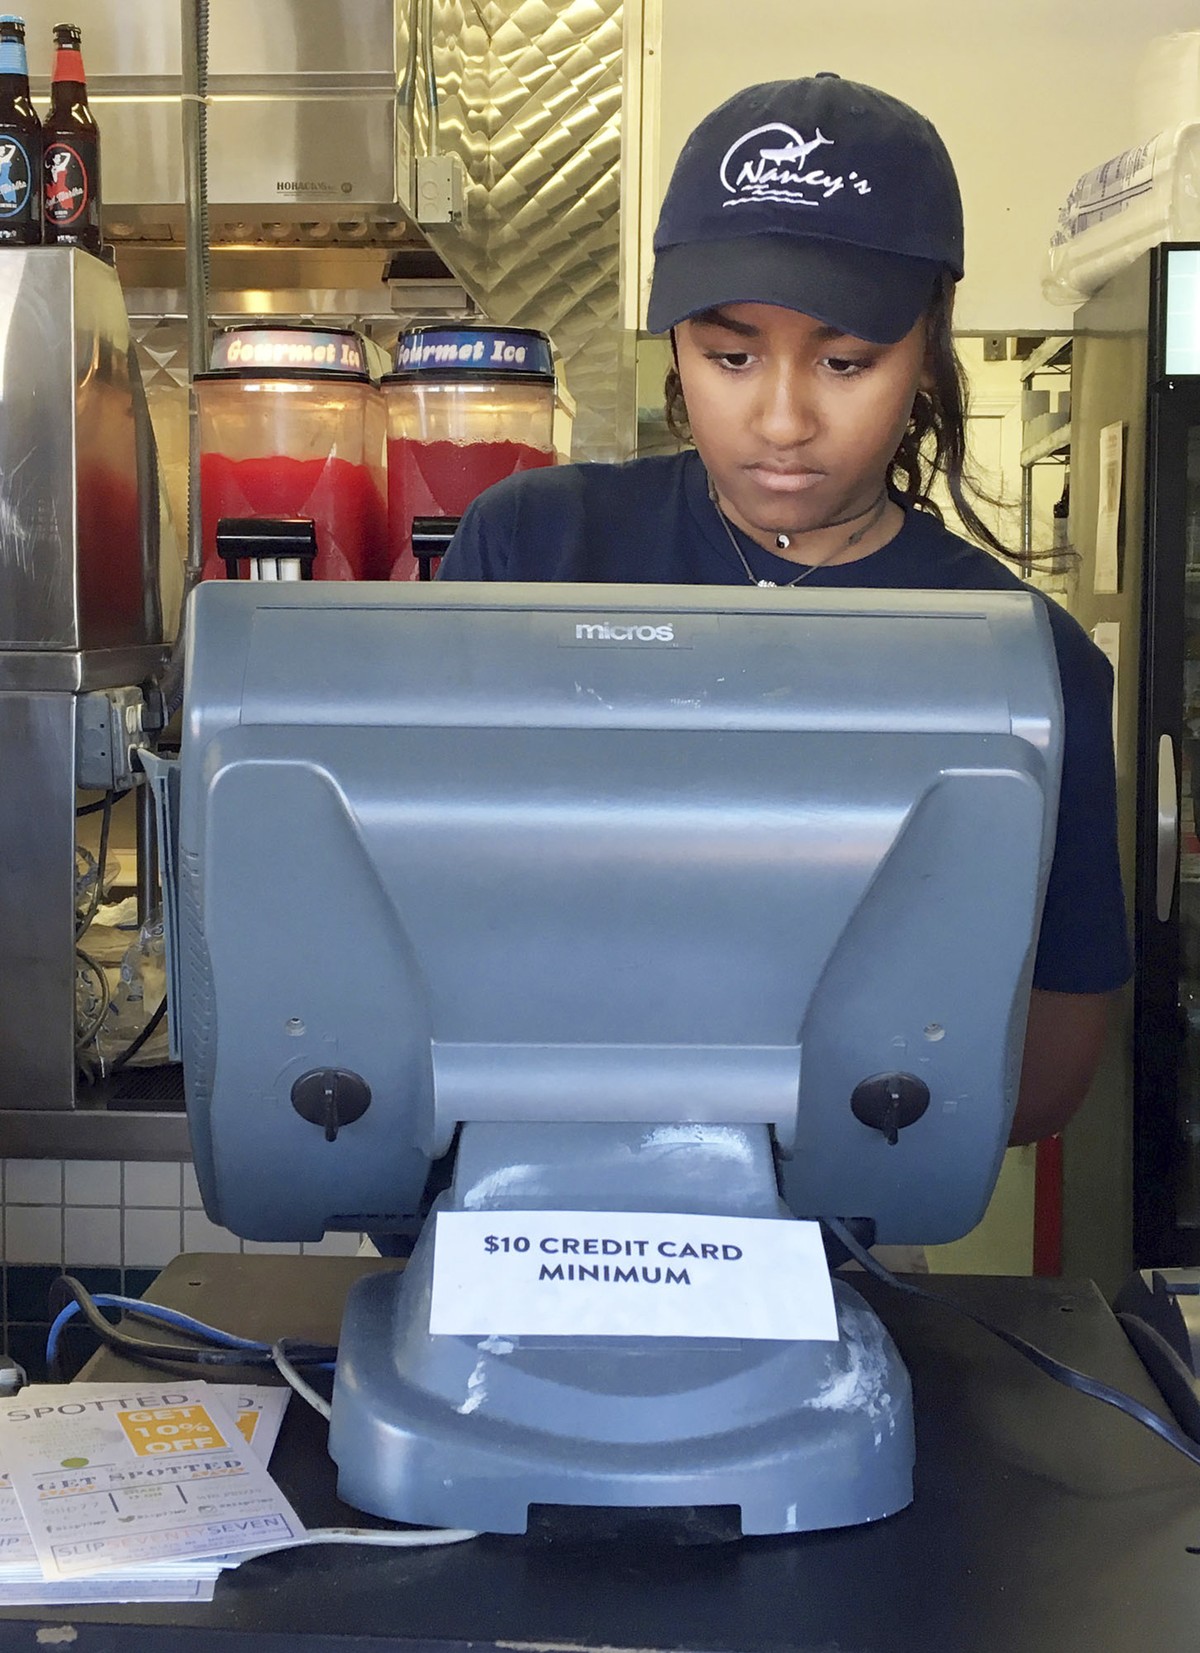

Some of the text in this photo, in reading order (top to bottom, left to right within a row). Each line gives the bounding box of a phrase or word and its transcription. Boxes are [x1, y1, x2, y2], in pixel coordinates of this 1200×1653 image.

[736, 158, 872, 198] Nancy's
[227, 339, 336, 363] Gourmet
[490, 340, 526, 363] Ice
[575, 622, 675, 642] micros
[484, 1235, 744, 1261] $10 CREDIT CARD
[538, 1263, 692, 1285] MINIMUM
[128, 1408, 196, 1423] GET
[134, 1422, 211, 1438] 10%
[145, 1436, 214, 1454] OFF
[37, 1460, 242, 1491] GET SPOTTED
